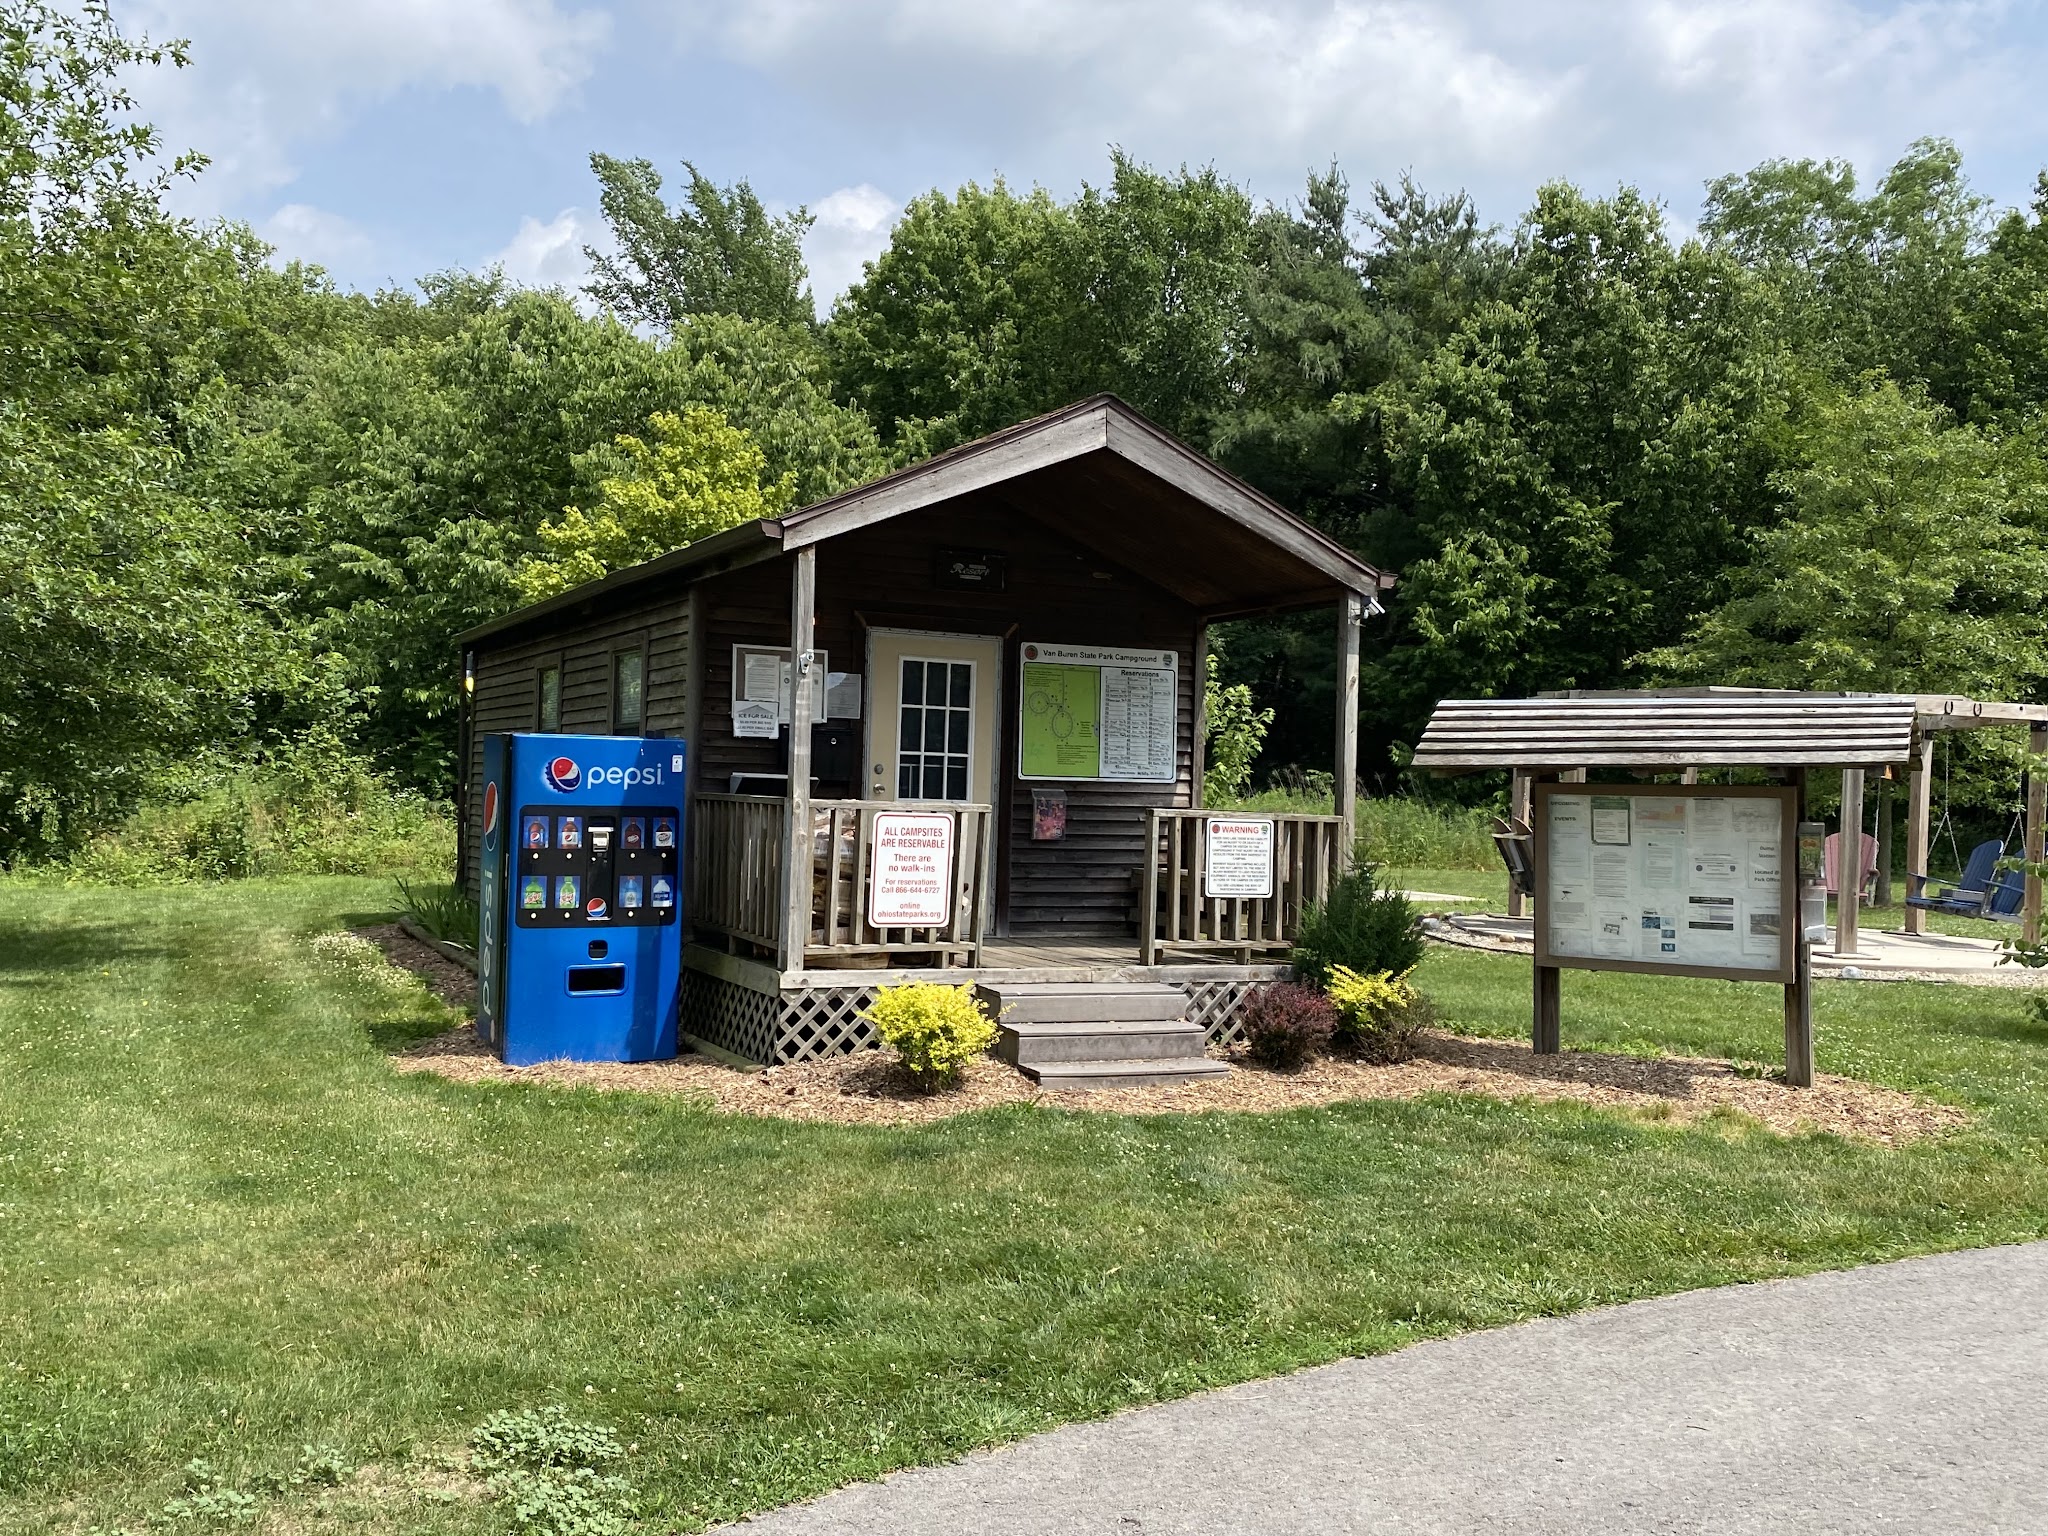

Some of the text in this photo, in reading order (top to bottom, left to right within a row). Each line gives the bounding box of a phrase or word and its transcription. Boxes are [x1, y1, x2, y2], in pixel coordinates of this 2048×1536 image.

[1115, 654, 1158, 664] Campground
[1121, 669, 1159, 678] Reservations
[587, 763, 662, 790] pepsi
[884, 827, 943, 837] ALL CAMPSITES
[881, 839, 945, 848] ARE RESERVABLE
[894, 854, 916, 862] There
[901, 864, 936, 872] walk-ins
[878, 911, 941, 919] ohiostateparks.org
[482, 869, 493, 1016] pepsi
